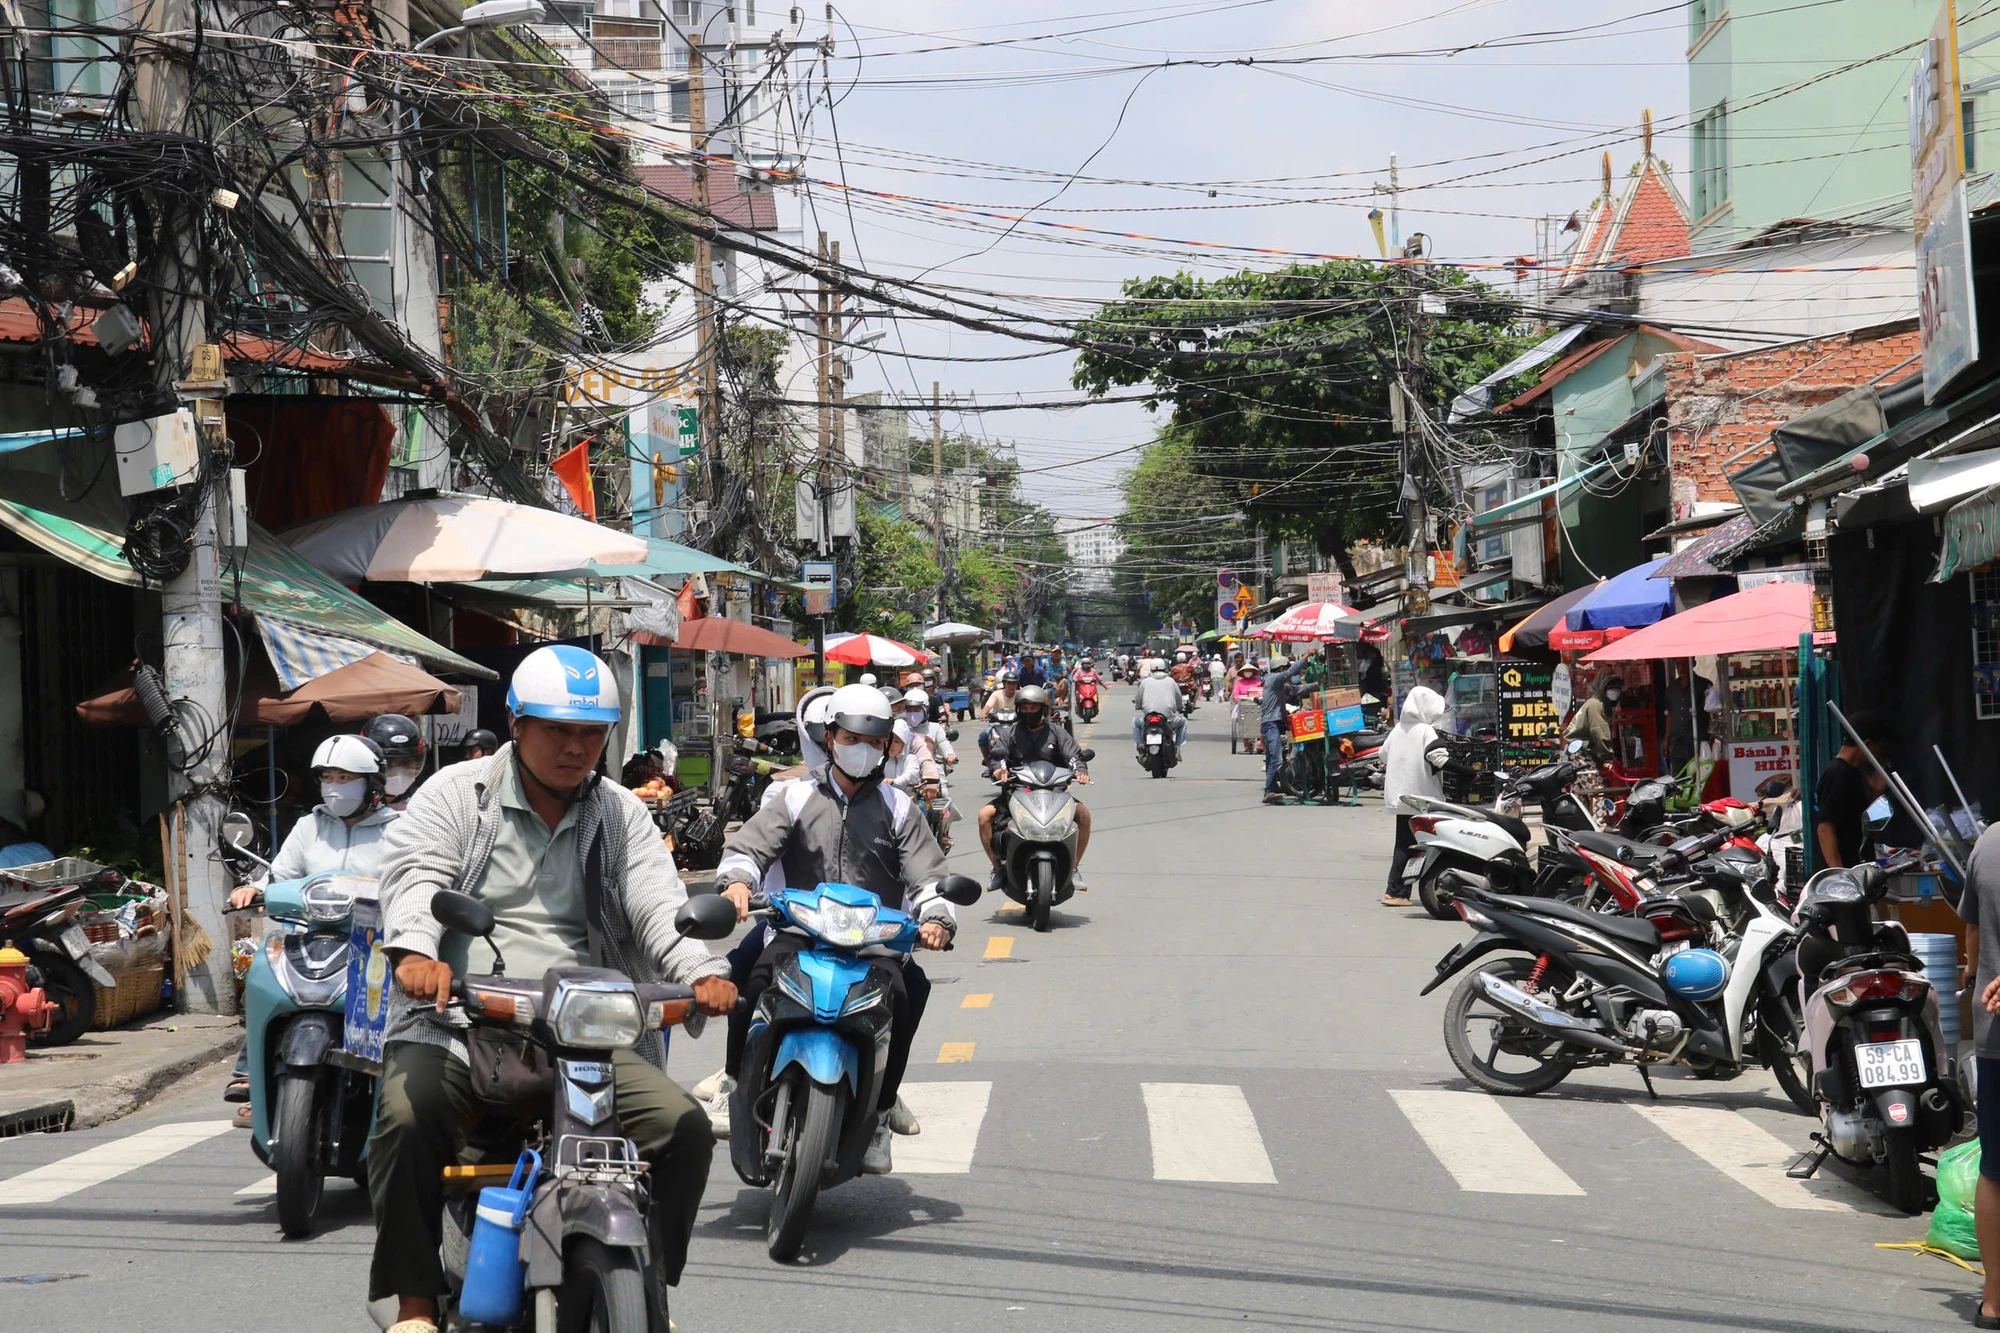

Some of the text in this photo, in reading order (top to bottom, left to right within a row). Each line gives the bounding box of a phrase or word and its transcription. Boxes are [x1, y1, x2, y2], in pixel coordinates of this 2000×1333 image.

[1734, 746, 1777, 759] Bánh
[1866, 1044, 1912, 1065] 59-CA
[574, 1065, 613, 1075] HONDA
[1864, 1062, 1921, 1084] 084.99
